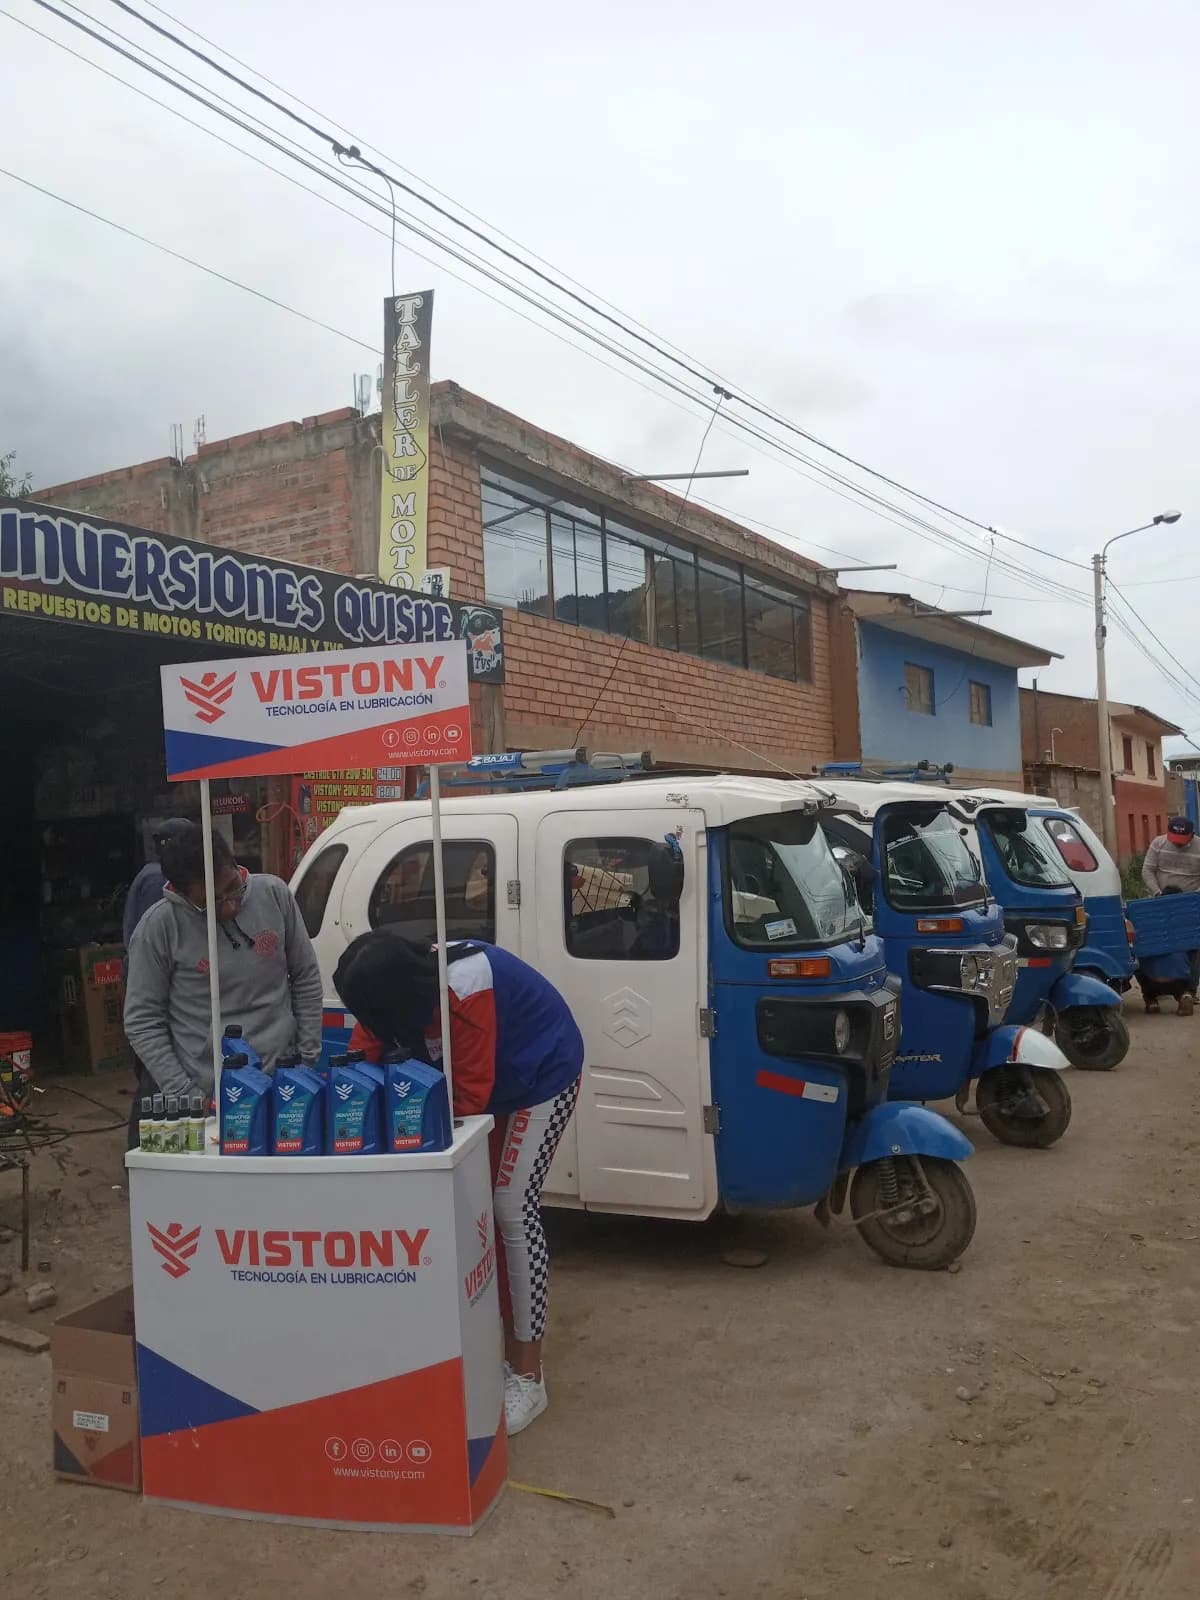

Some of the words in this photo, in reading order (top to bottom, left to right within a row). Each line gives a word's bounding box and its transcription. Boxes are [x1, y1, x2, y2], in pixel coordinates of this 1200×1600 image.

[392, 295, 423, 459] TALLER
[392, 463, 417, 483] DE
[3, 587, 111, 625] REPUESTOS
[117, 607, 139, 629] DE
[144, 611, 201, 638] MOTOS
[205, 622, 266, 648] TORITOS
[269, 632, 307, 653] BAJAJ
[311, 639, 320, 652] Y
[334, 582, 455, 644] QUISPE
[474, 655, 491, 671] TVS
[250, 656, 445, 703] VISTONY
[265, 700, 337, 717] TECNOLOGÍA
[340, 701, 354, 711] EN
[357, 692, 433, 709] LUBRICACIÓN
[388, 747, 458, 759] www.vistony.com
[482, 754, 516, 764] BAJAJ
[314, 784, 341, 796] VISTONY
[215, 1228, 430, 1267] VISTONY
[231, 1269, 307, 1284] TECNOLOGÍA
[310, 1272, 327, 1284] EN
[331, 1269, 416, 1285] LUBRICACIÓN
[333, 1467, 425, 1480] www.vistony.com
